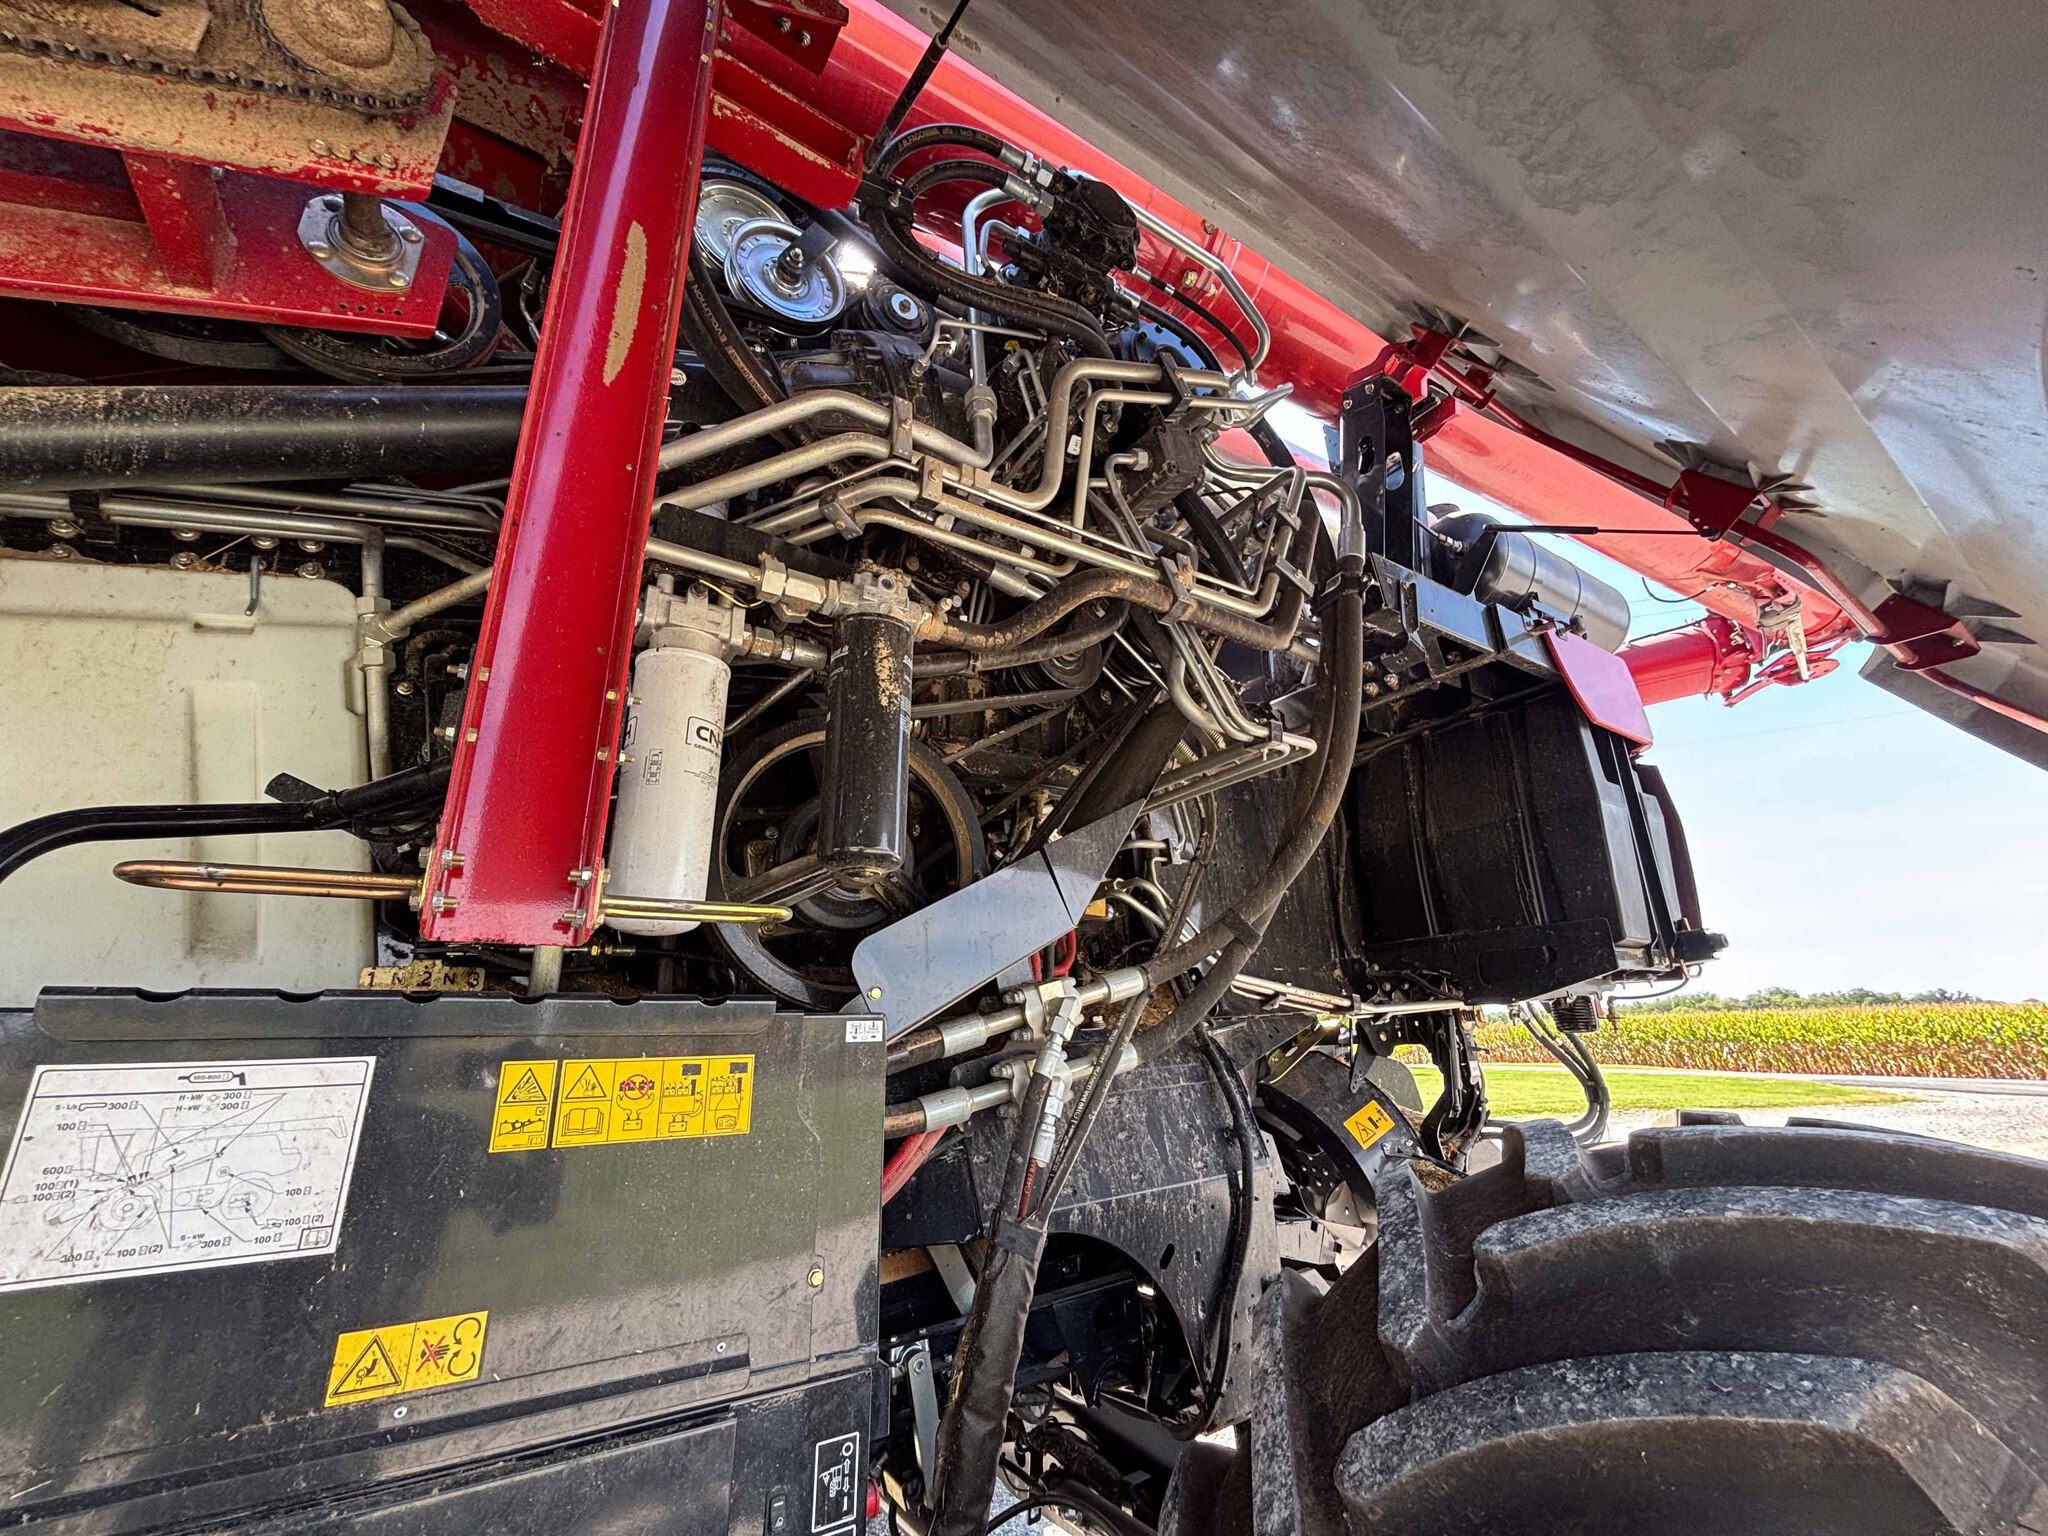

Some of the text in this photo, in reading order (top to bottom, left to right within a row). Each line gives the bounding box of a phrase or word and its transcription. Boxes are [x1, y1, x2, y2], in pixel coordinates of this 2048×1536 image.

[691, 284, 727, 343] EVOLUTION
[367, 972, 375, 987] 1
[417, 971, 431, 986] 2
[443, 973, 455, 985] N
[223, 1092, 242, 1100] 300
[108, 1102, 128, 1110] 300
[220, 1102, 239, 1110] 300
[56, 1123, 76, 1131] 100
[42, 1167, 64, 1175] 600
[35, 1183, 55, 1191] 100
[285, 1188, 302, 1196] 100
[32, 1193, 52, 1201] 100
[284, 1218, 301, 1226] 100
[254, 1236, 271, 1244] 100
[200, 1240, 220, 1249] 300
[117, 1249, 136, 1257] 100
